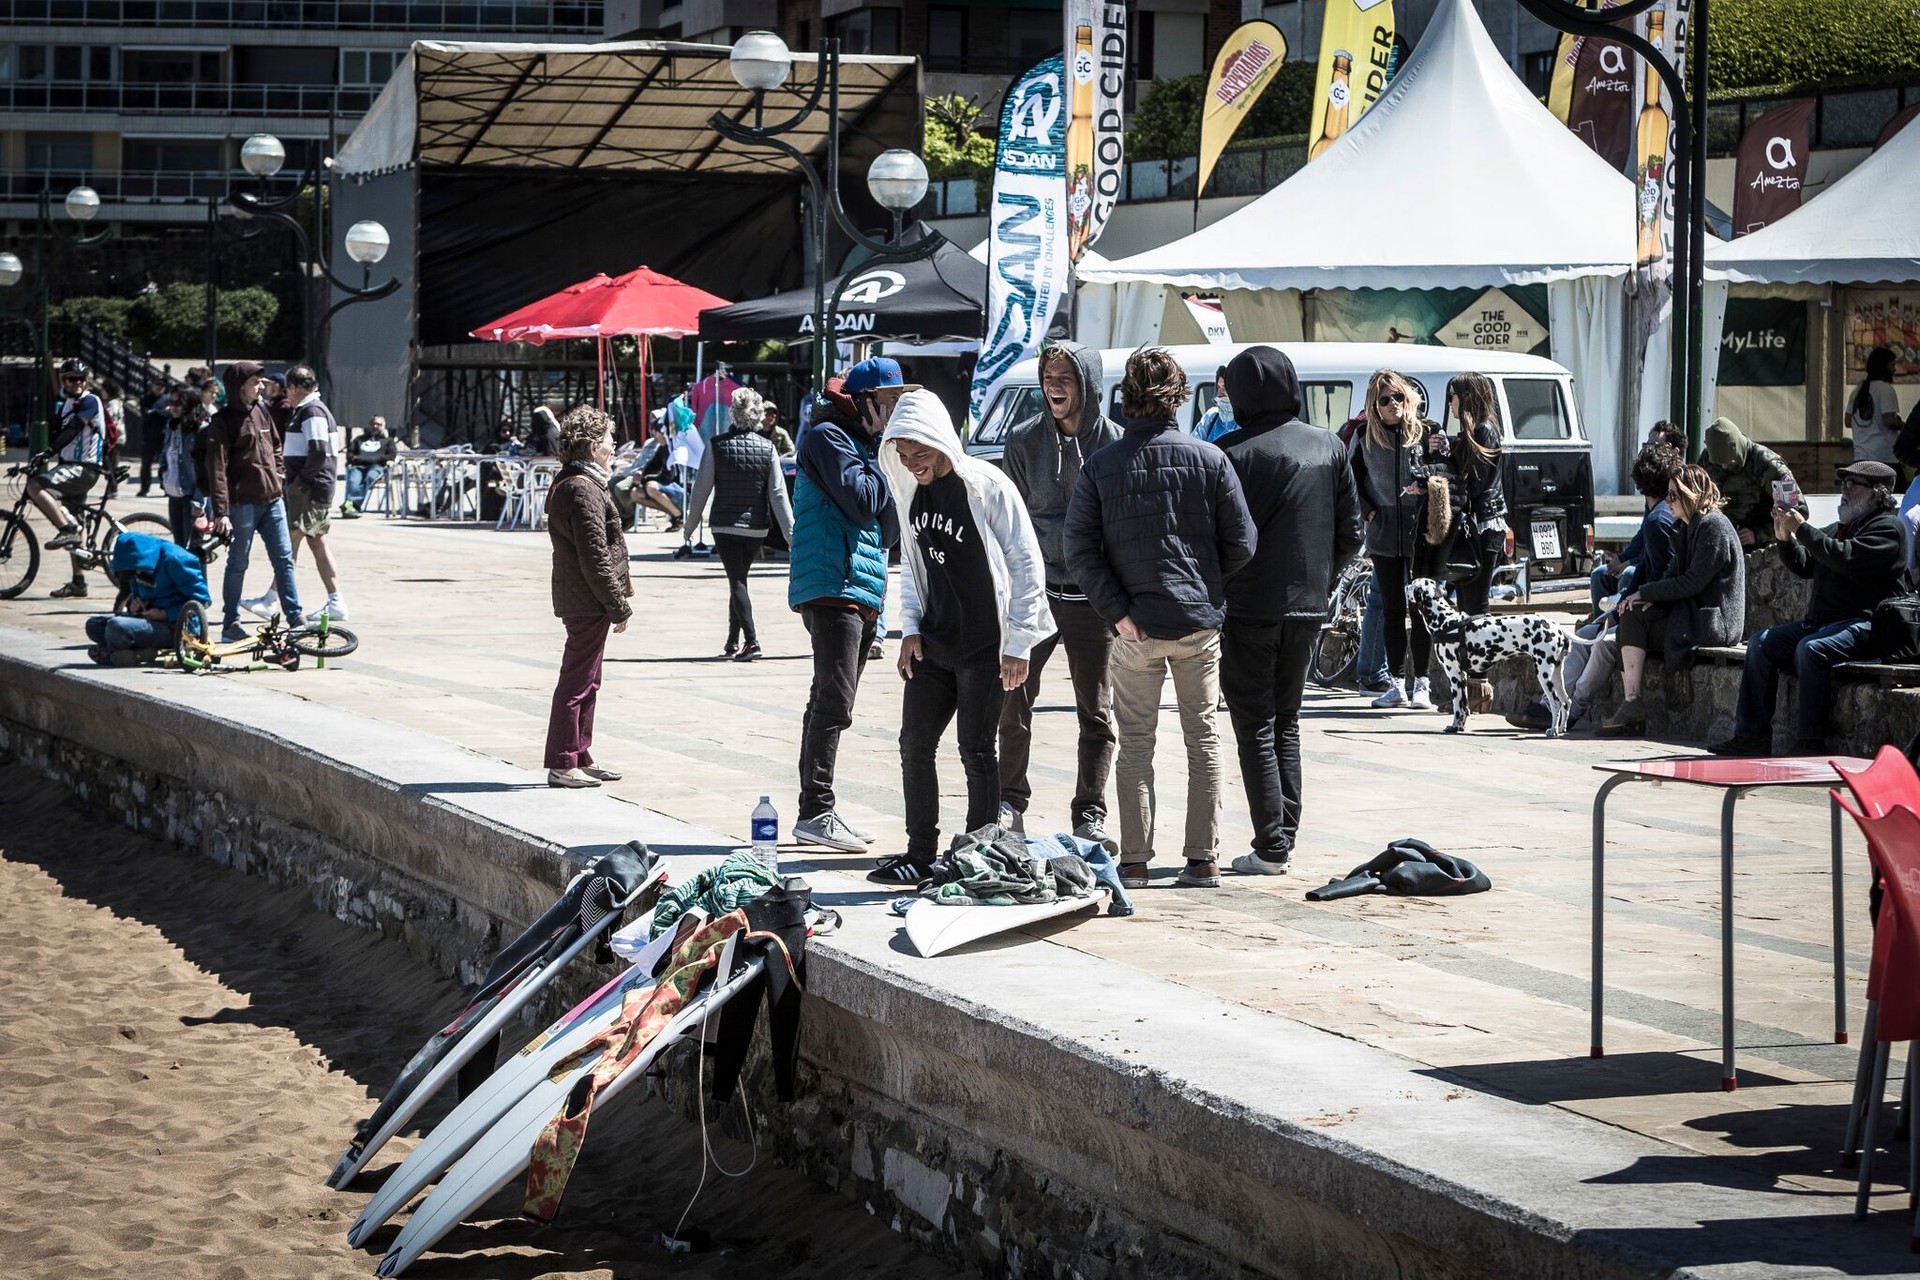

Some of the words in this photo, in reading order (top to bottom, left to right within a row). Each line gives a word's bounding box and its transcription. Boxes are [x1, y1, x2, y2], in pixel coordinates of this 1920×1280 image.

[1099, 0, 1126, 98] CIDE
[1215, 39, 1271, 105] DESPERADOS
[1361, 25, 1393, 115] IDER
[1095, 109, 1122, 226] GOOD
[1045, 198, 1055, 262] CHALLENGES
[1043, 266, 1053, 279] BY
[1036, 281, 1051, 318] UNITED
[1208, 327, 1225, 336] DKV
[1473, 322, 1511, 333] GOOD
[1481, 311, 1505, 322] THE
[1474, 334, 1510, 345] CIDER
[1721, 329, 1786, 353] MyLife
